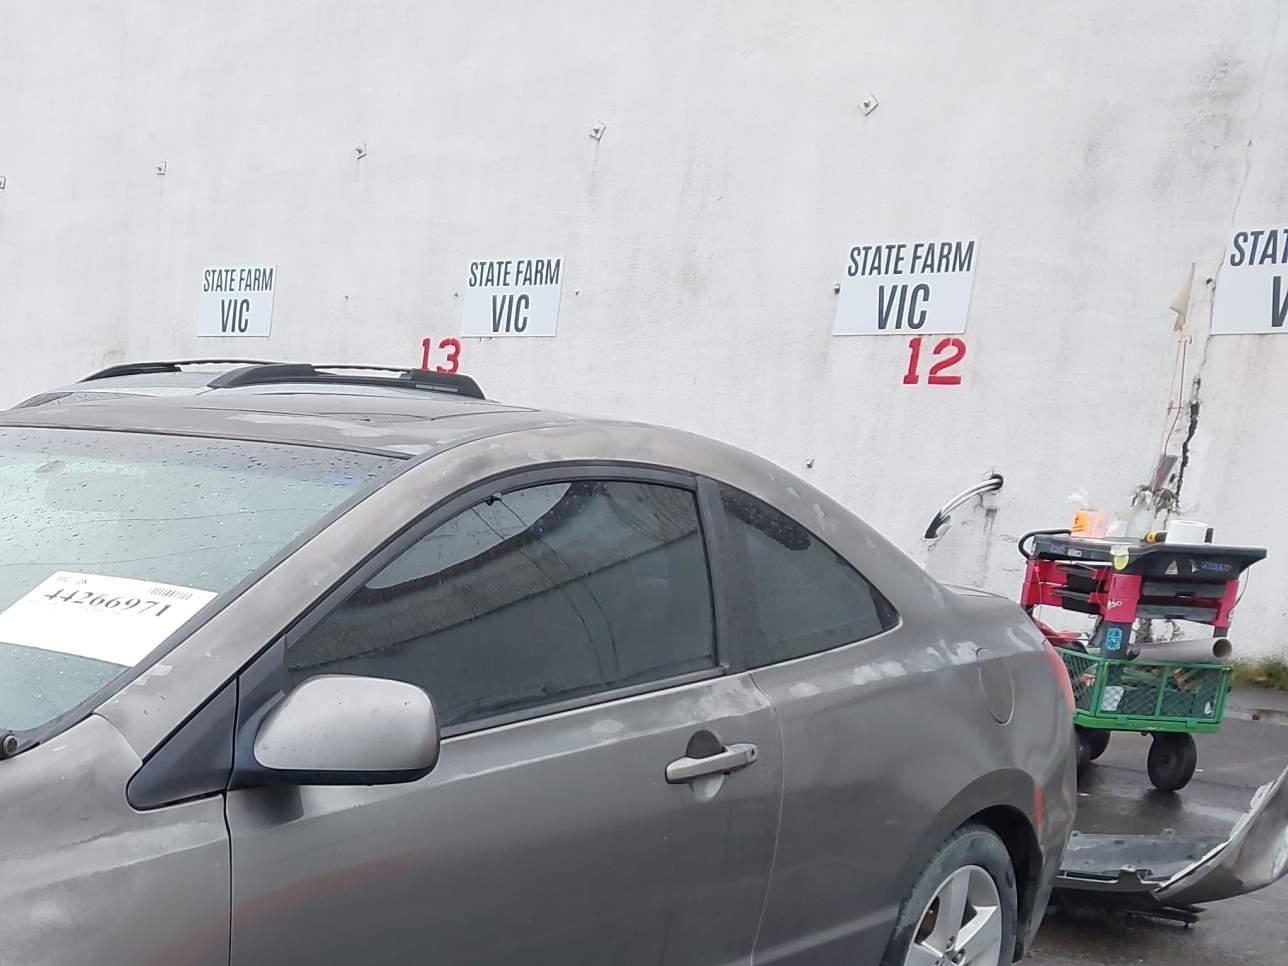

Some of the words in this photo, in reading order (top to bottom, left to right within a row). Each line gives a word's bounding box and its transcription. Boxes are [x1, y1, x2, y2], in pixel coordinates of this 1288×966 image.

[468, 260, 513, 288] STATE
[513, 258, 561, 286] FARM
[847, 243, 909, 277] STATE
[909, 240, 976, 274] FARM
[203, 269, 237, 293] STATE
[237, 267, 274, 292] FARM
[221, 298, 250, 334] VIC
[492, 293, 530, 333] VIC
[877, 283, 930, 330] VIC
[420, 336, 462, 375] 13
[901, 335, 969, 389] 12
[43, 587, 173, 617] 44266971
